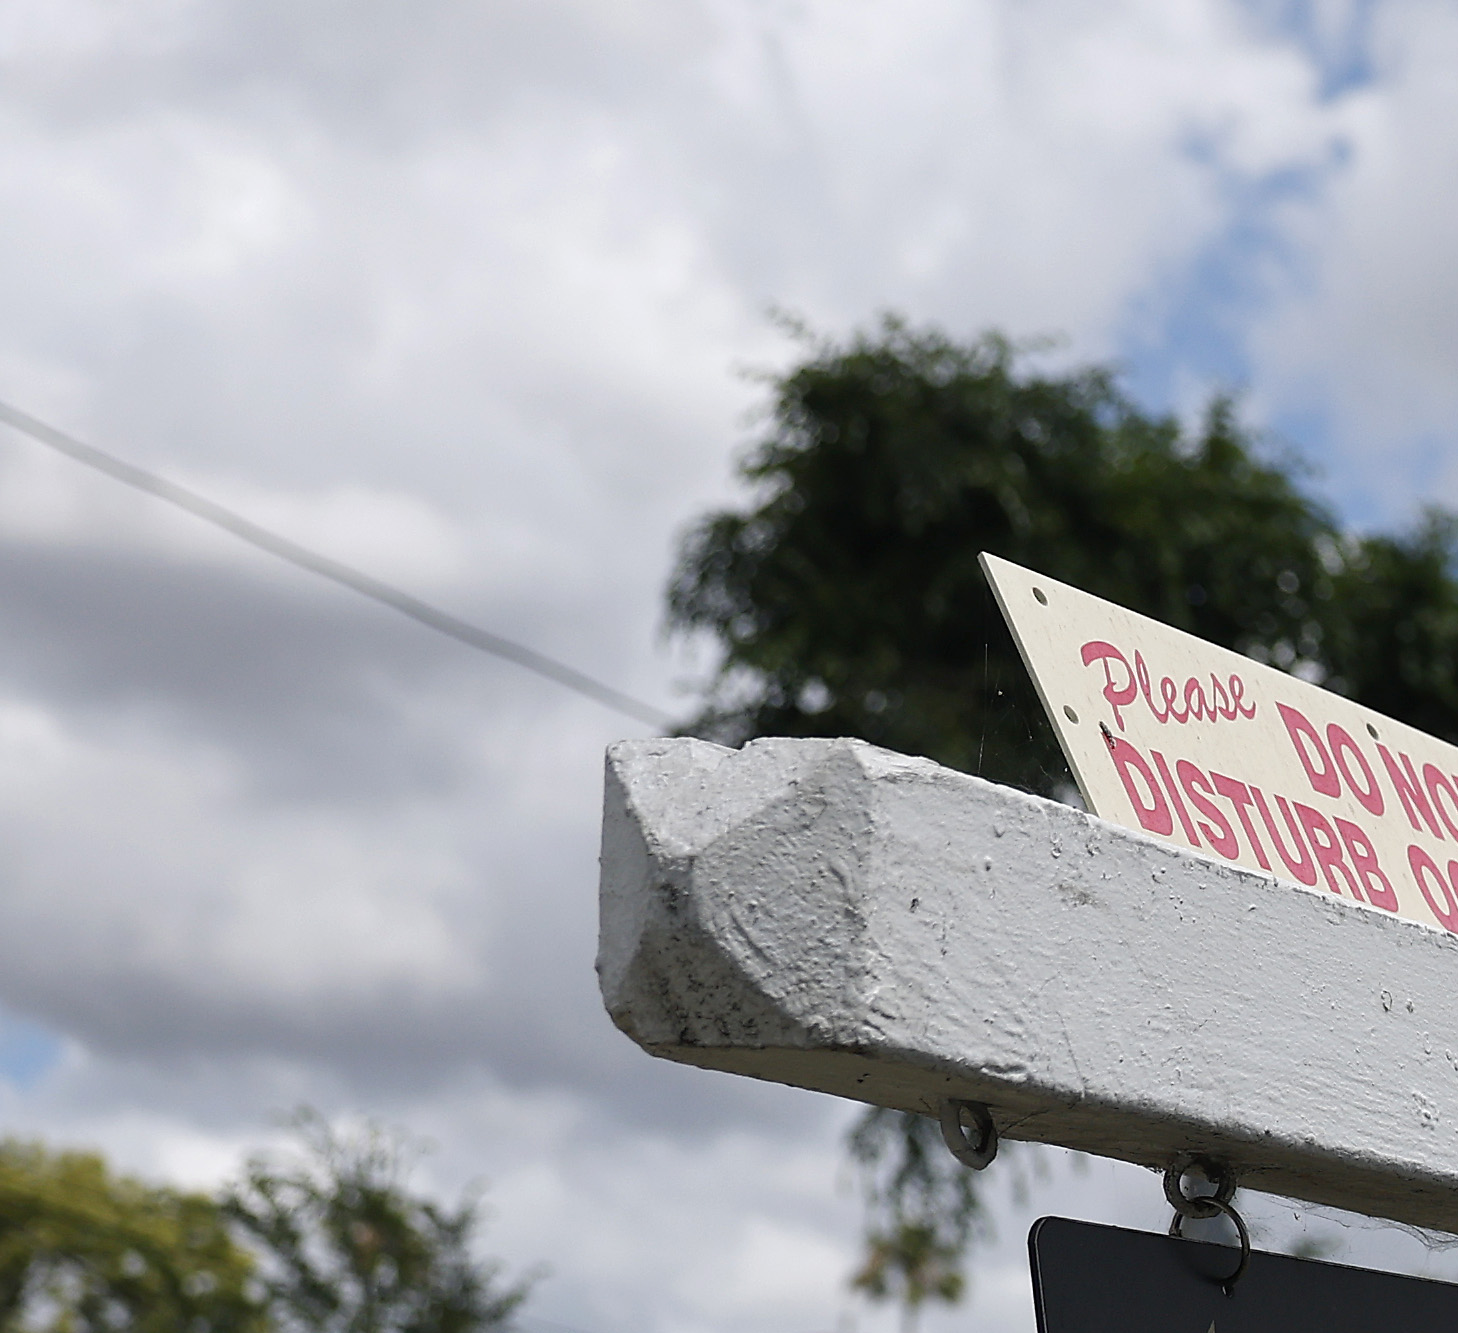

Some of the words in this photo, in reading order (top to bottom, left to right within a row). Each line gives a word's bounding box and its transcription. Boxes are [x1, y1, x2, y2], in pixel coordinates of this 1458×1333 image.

[1080, 639, 1256, 732] Please
[1276, 701, 1385, 816] DO
[1102, 731, 1399, 912] DISTURB
